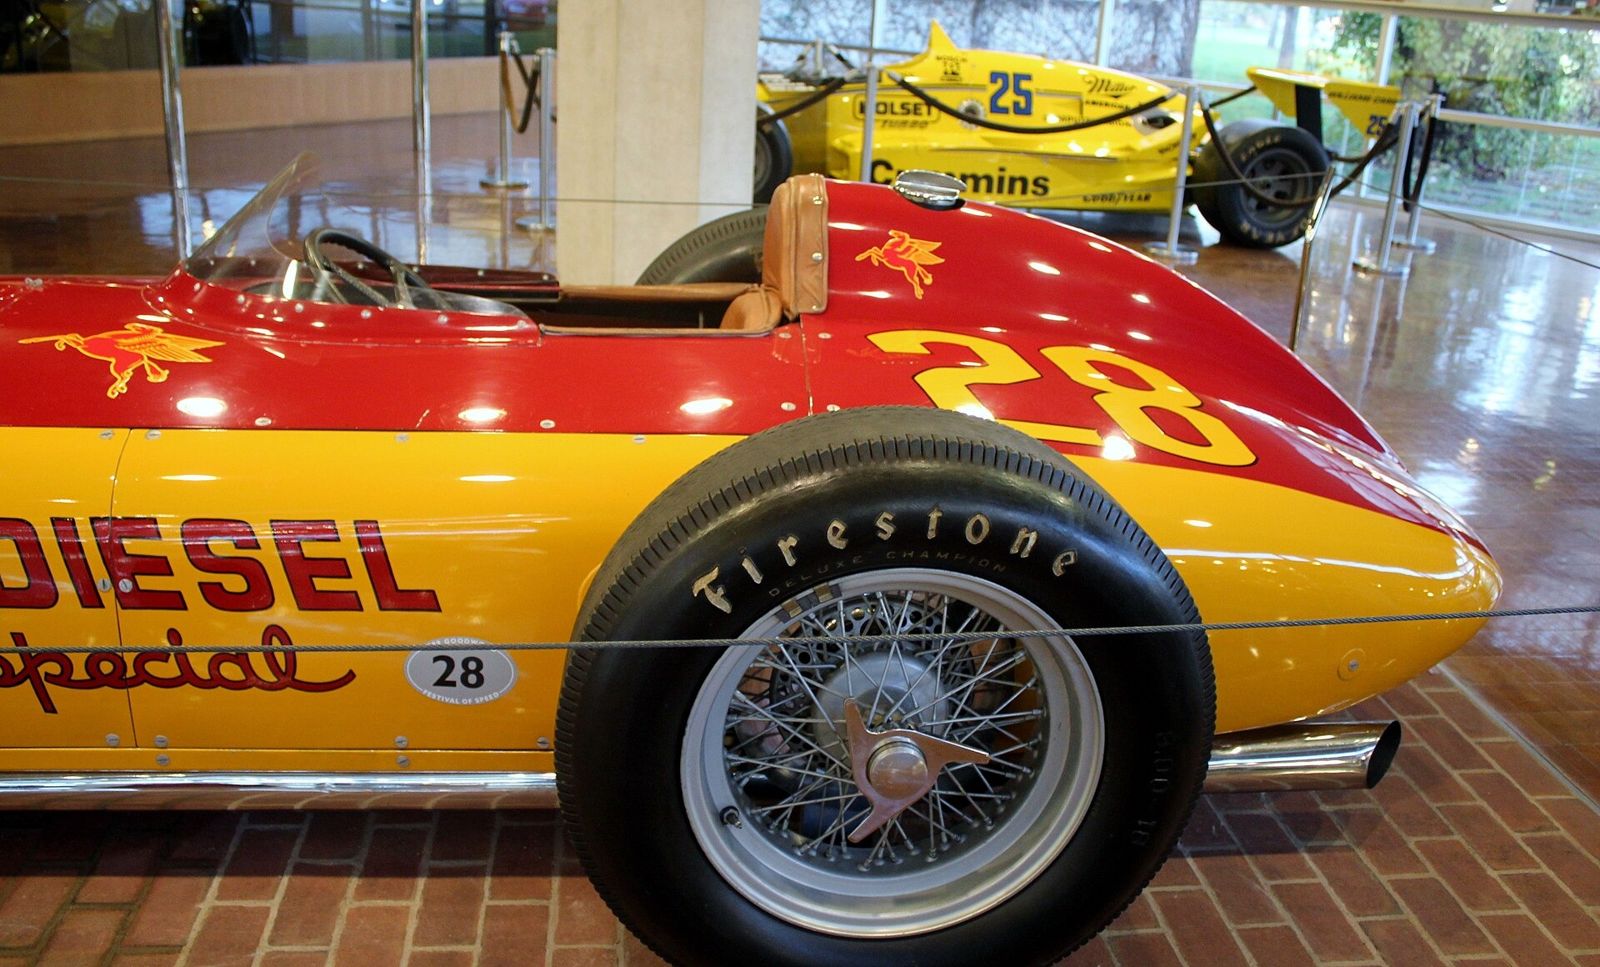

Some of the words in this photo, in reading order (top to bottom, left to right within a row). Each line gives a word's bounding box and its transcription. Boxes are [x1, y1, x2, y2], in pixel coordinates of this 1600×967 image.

[990, 72, 1033, 116] 25
[1366, 114, 1389, 136] 25
[870, 159, 1051, 197] Cmins
[866, 329, 1258, 467] 28
[0, 516, 442, 613] DIESEL
[691, 504, 1079, 614] Firestone
[768, 555, 864, 598] DELUXE
[885, 551, 1007, 573] CHAMPION
[0, 623, 357, 714] pecial
[432, 655, 485, 689] 28
[422, 689, 460, 705] FESTIVAL
[474, 692, 500, 704] SPEED
